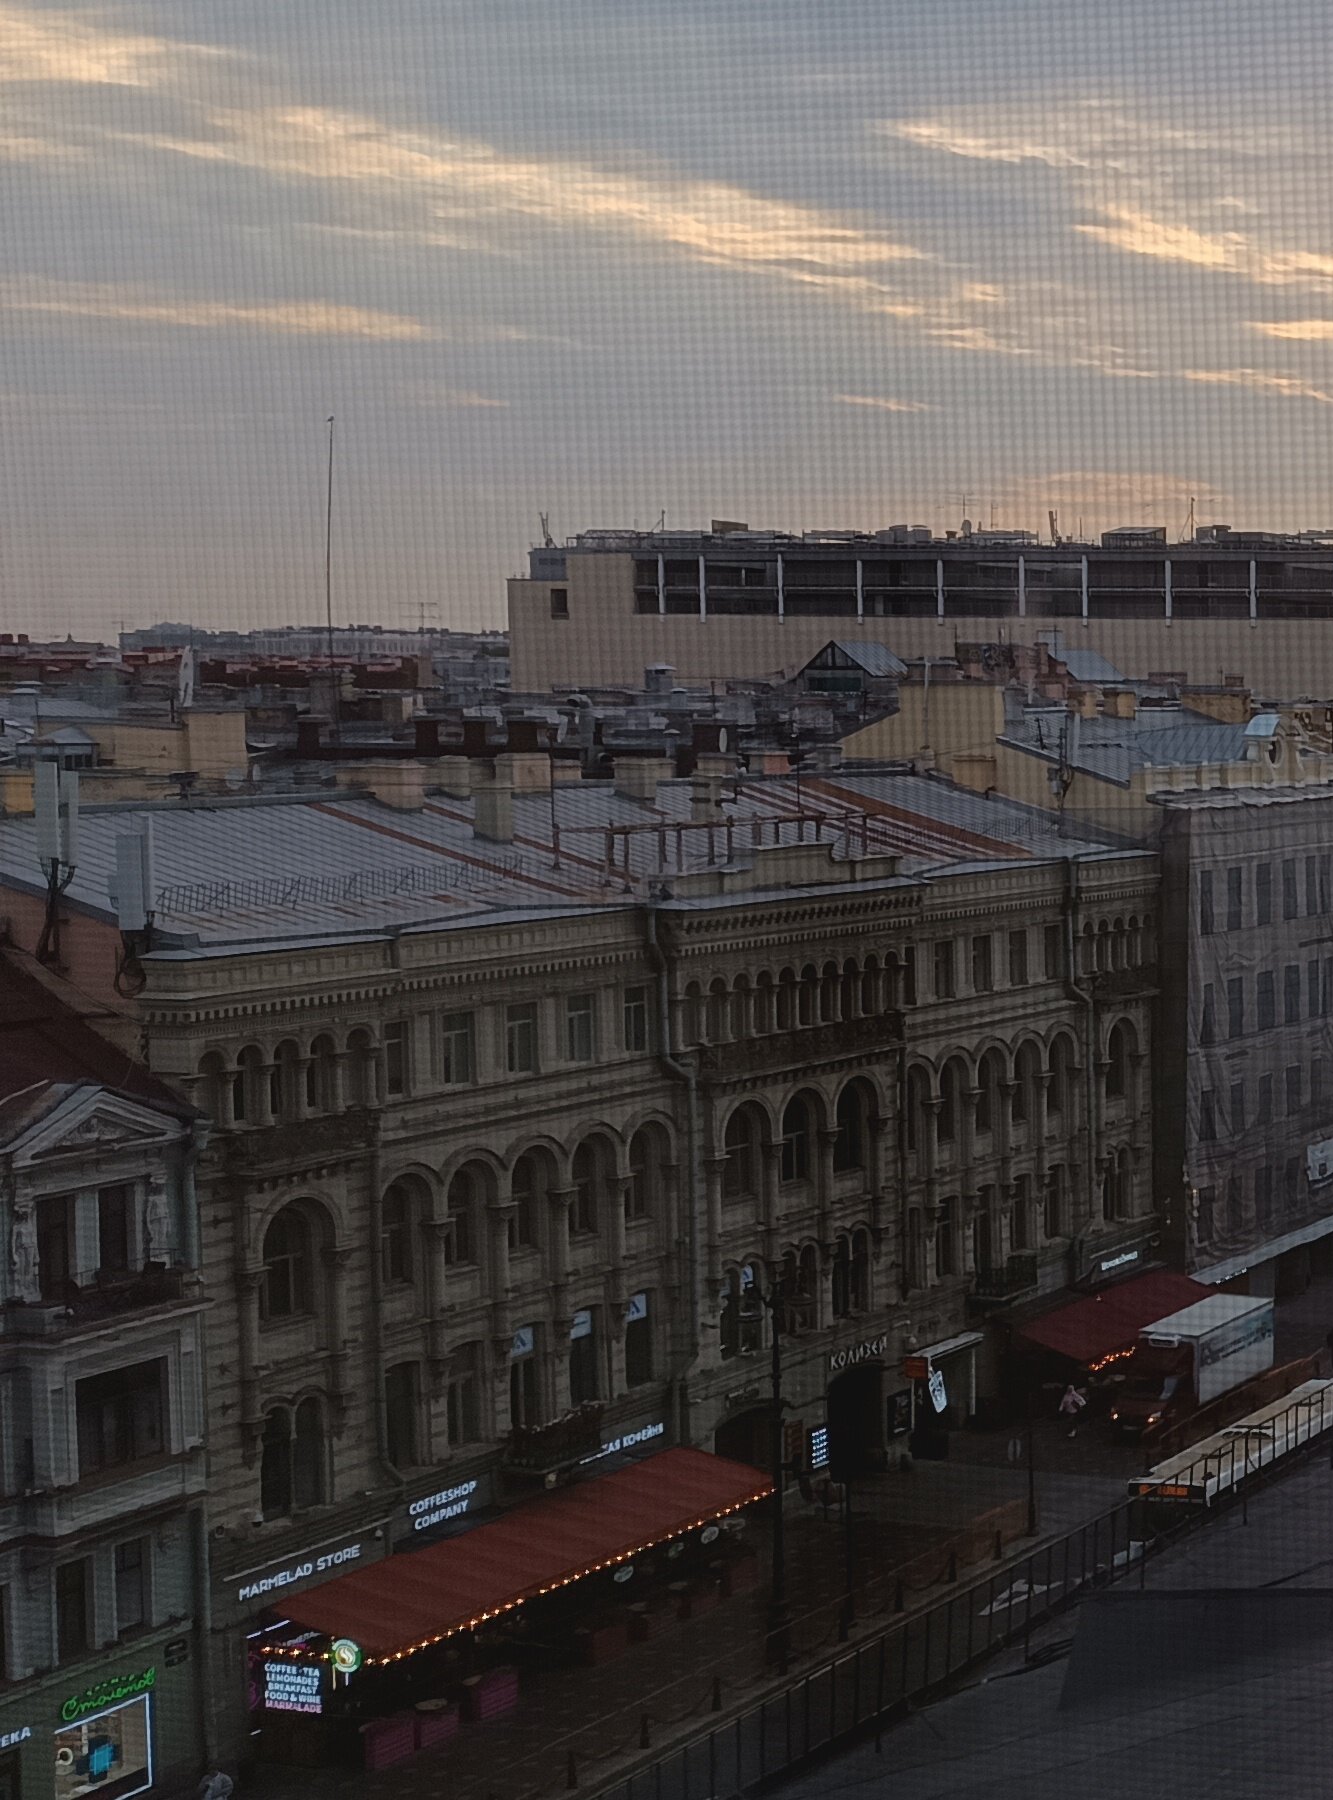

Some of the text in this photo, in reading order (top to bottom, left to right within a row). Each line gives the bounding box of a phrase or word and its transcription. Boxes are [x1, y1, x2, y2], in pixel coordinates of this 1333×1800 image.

[409, 1480, 477, 1515] COFFEESHOP
[414, 1499, 469, 1530] COMPANY
[238, 1543, 361, 1601] MARMELAD STORE
[264, 1663, 320, 1678] COFFEE TEA
[266, 1672, 319, 1686] LEMONADES
[264, 1690, 289, 1700] FOOD
[268, 1682, 318, 1694] BREAKFAST
